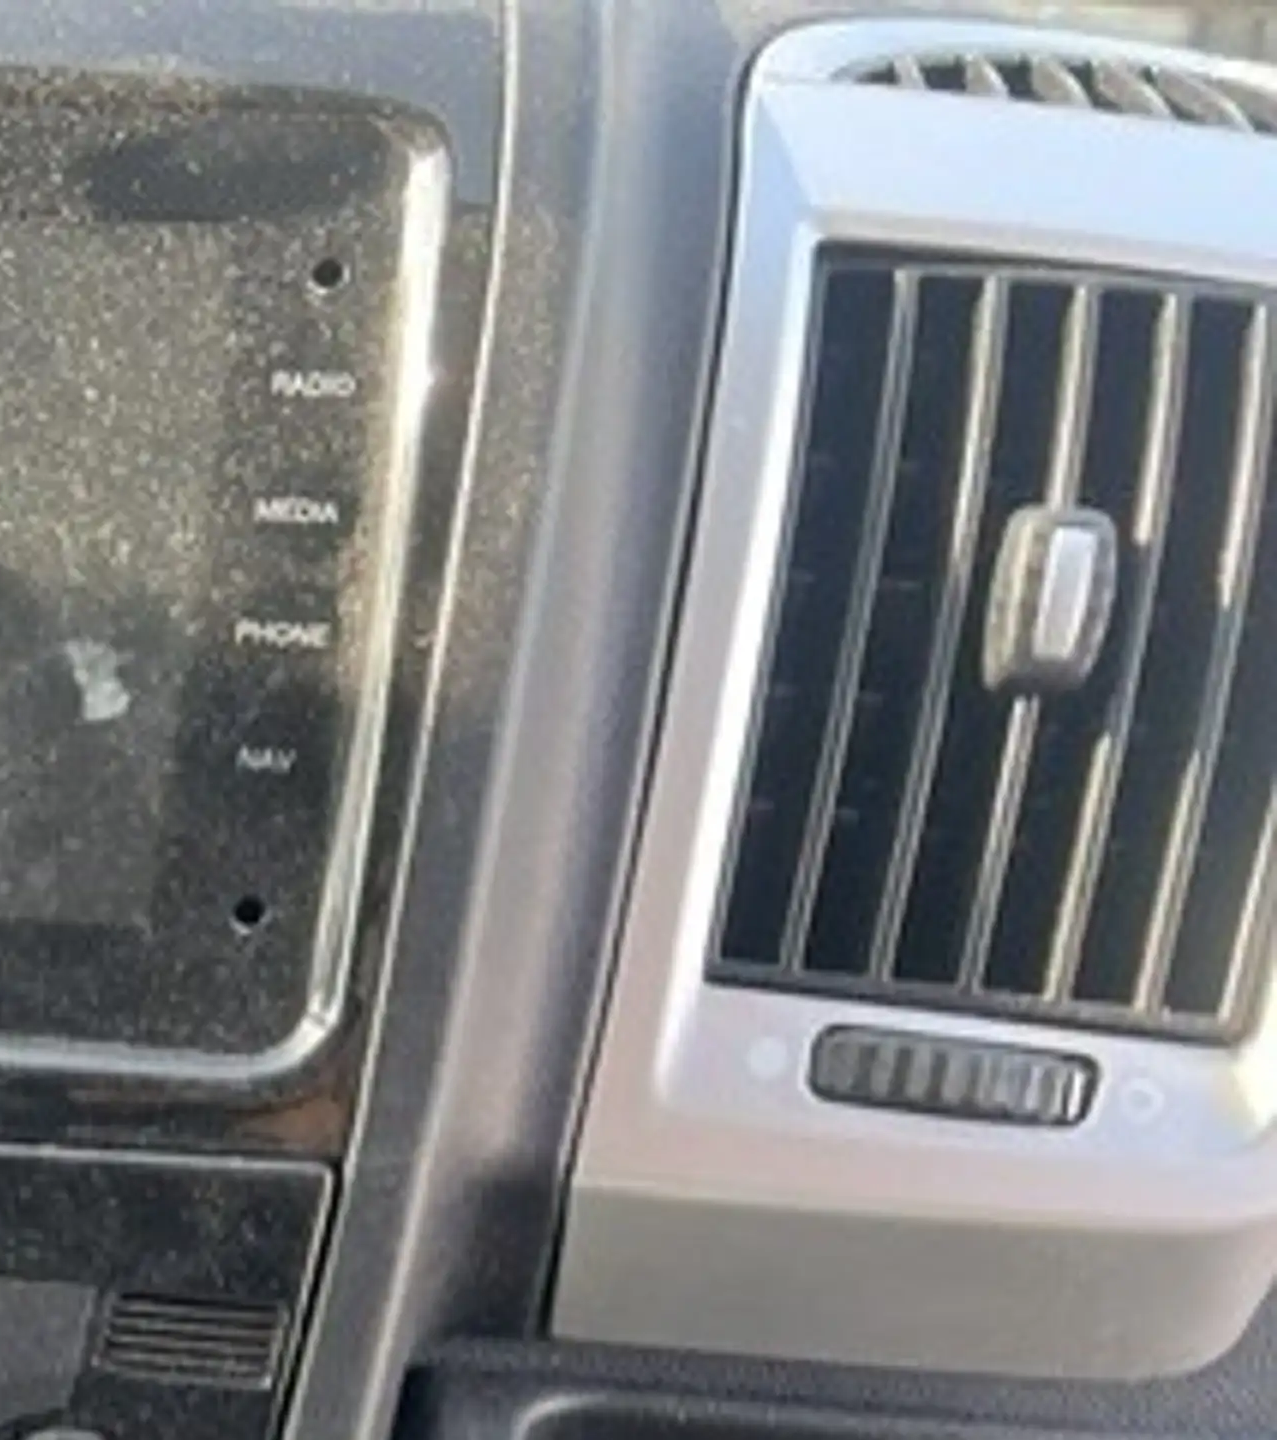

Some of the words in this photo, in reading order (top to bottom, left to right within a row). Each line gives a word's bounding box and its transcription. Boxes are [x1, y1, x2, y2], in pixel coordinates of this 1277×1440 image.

[270, 370, 356, 397] RADIO
[253, 497, 339, 524] MEDIA
[234, 618, 331, 649] PHONE
